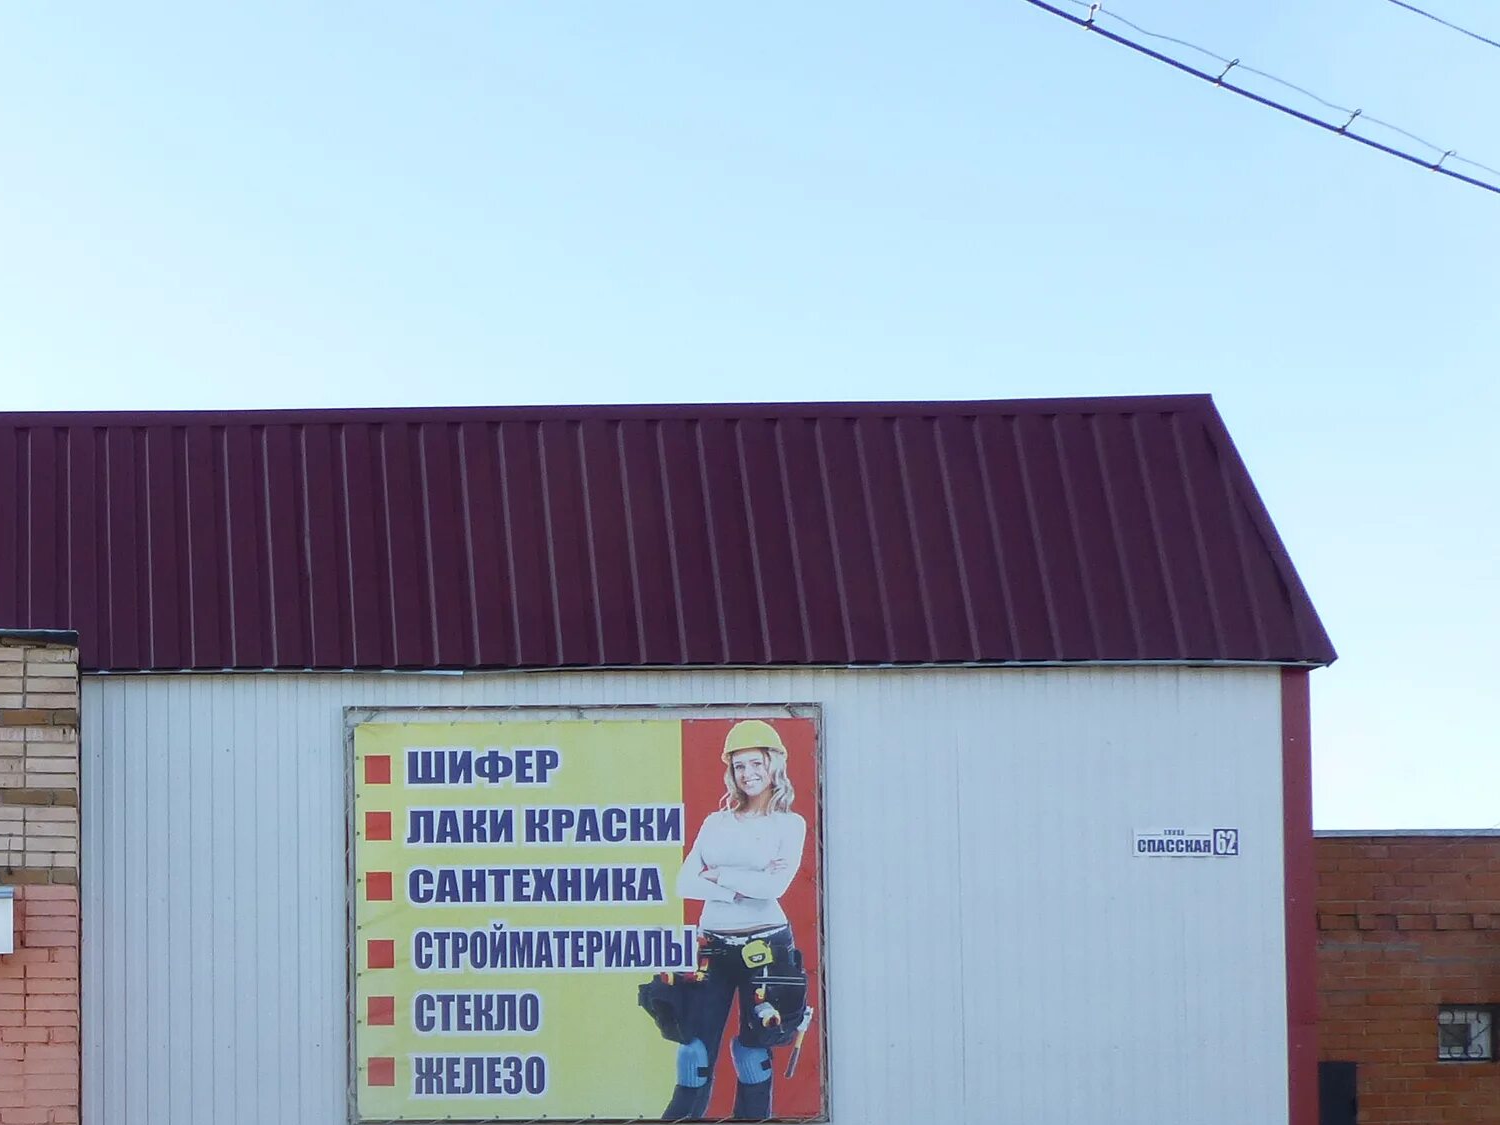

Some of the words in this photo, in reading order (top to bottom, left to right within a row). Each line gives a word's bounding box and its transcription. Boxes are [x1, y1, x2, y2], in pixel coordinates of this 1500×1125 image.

[406, 750, 559, 785] ШИФЕР
[406, 809, 514, 844] ЛАКИ
[525, 808, 681, 842] КРАСКИ
[1216, 831, 1237, 854] 62
[408, 868, 663, 903] САНТЕХНИКА
[414, 924, 693, 969] СТРОЙМАТЕРИАЛЫ
[414, 993, 540, 1031] СТЕКЛО
[415, 1056, 546, 1095] ЖЕЛЕЗО
